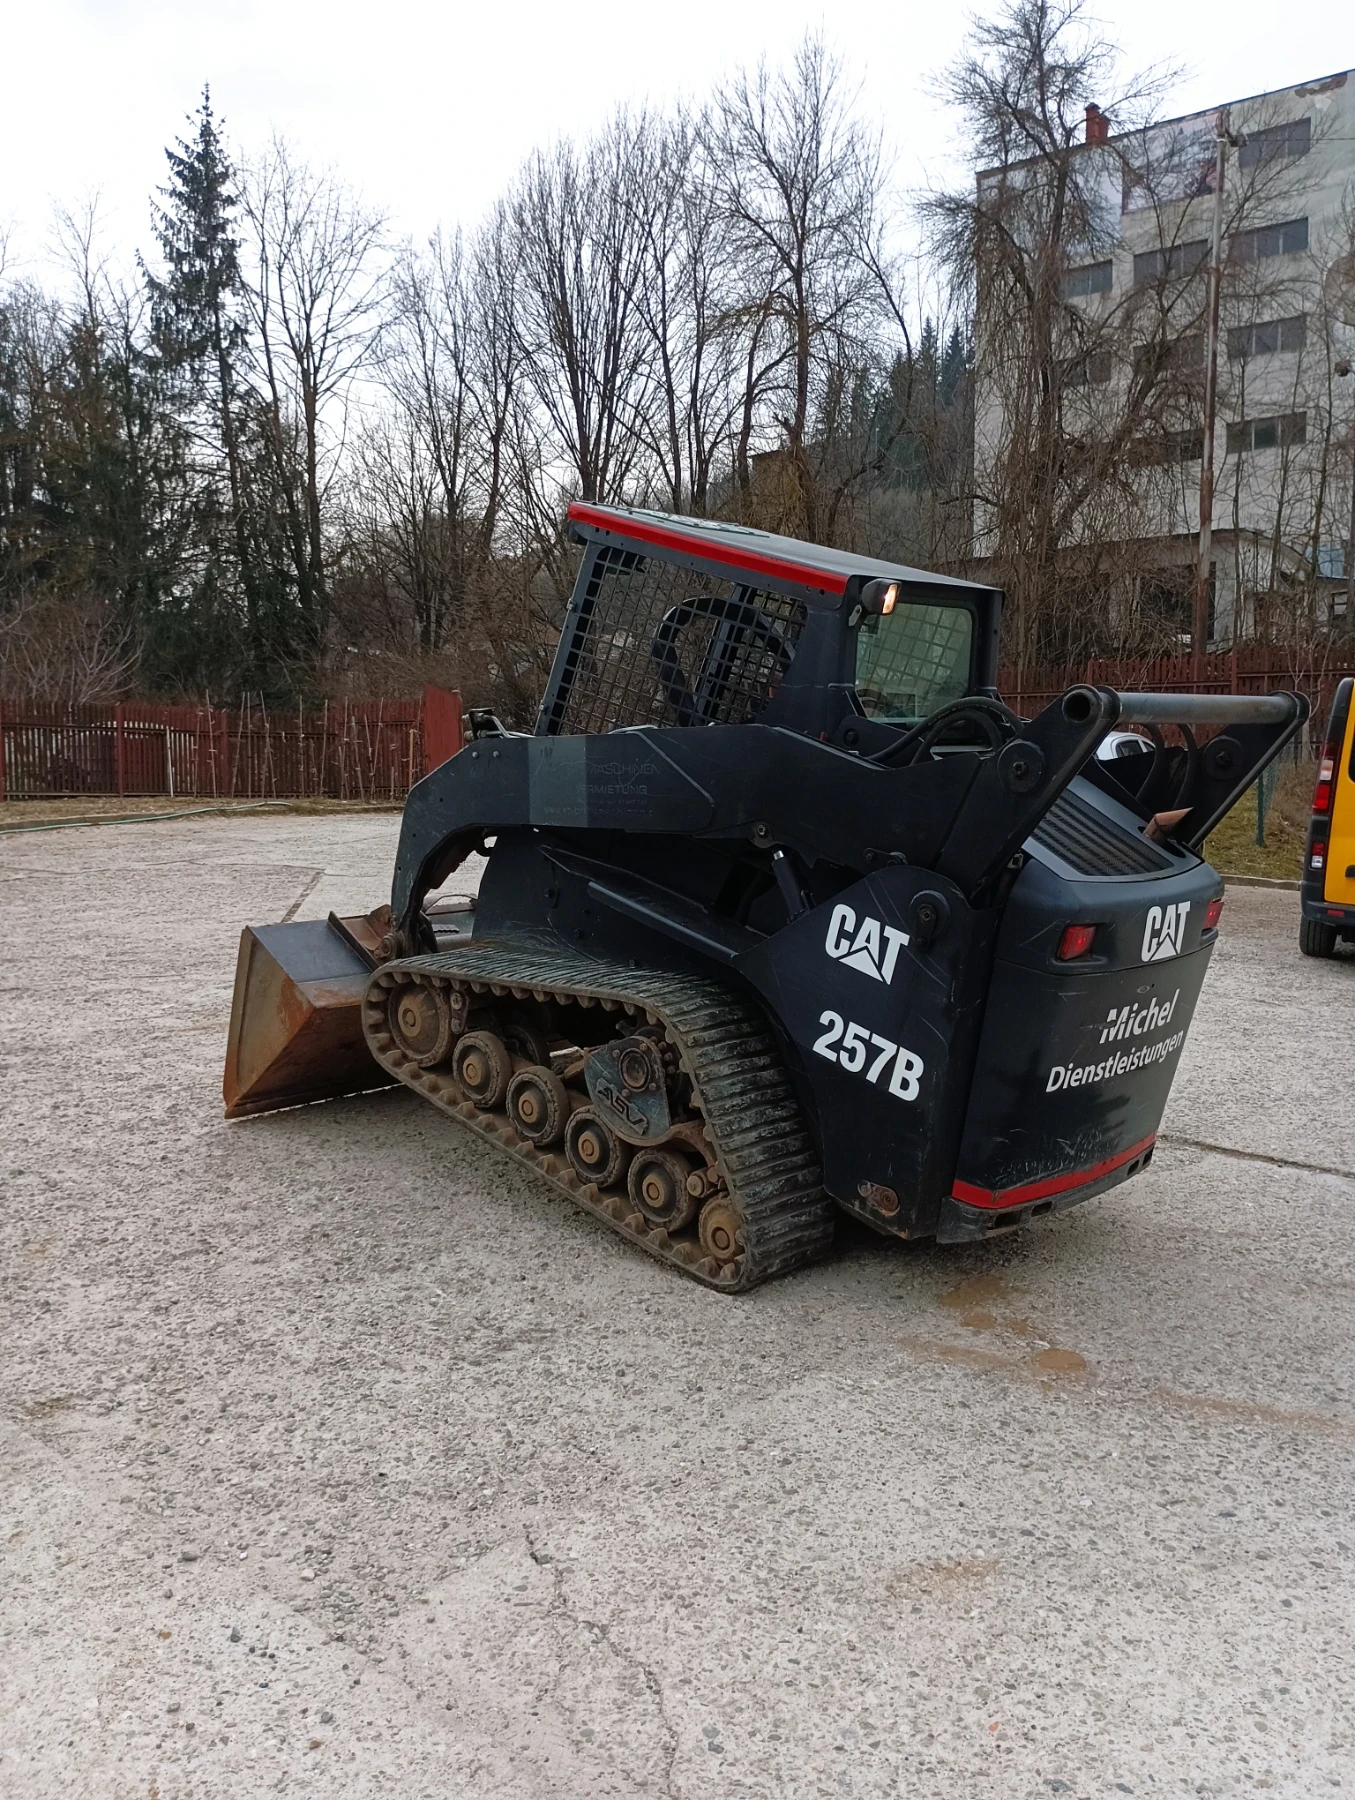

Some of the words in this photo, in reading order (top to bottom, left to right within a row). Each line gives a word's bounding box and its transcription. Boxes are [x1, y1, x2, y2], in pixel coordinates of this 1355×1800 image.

[825, 903, 910, 985] CAT
[1141, 901, 1191, 962] CAT
[1100, 988, 1181, 1044] Michel
[812, 1010, 925, 1102] 257B
[1045, 1030, 1184, 1093] Dienstleistungen
